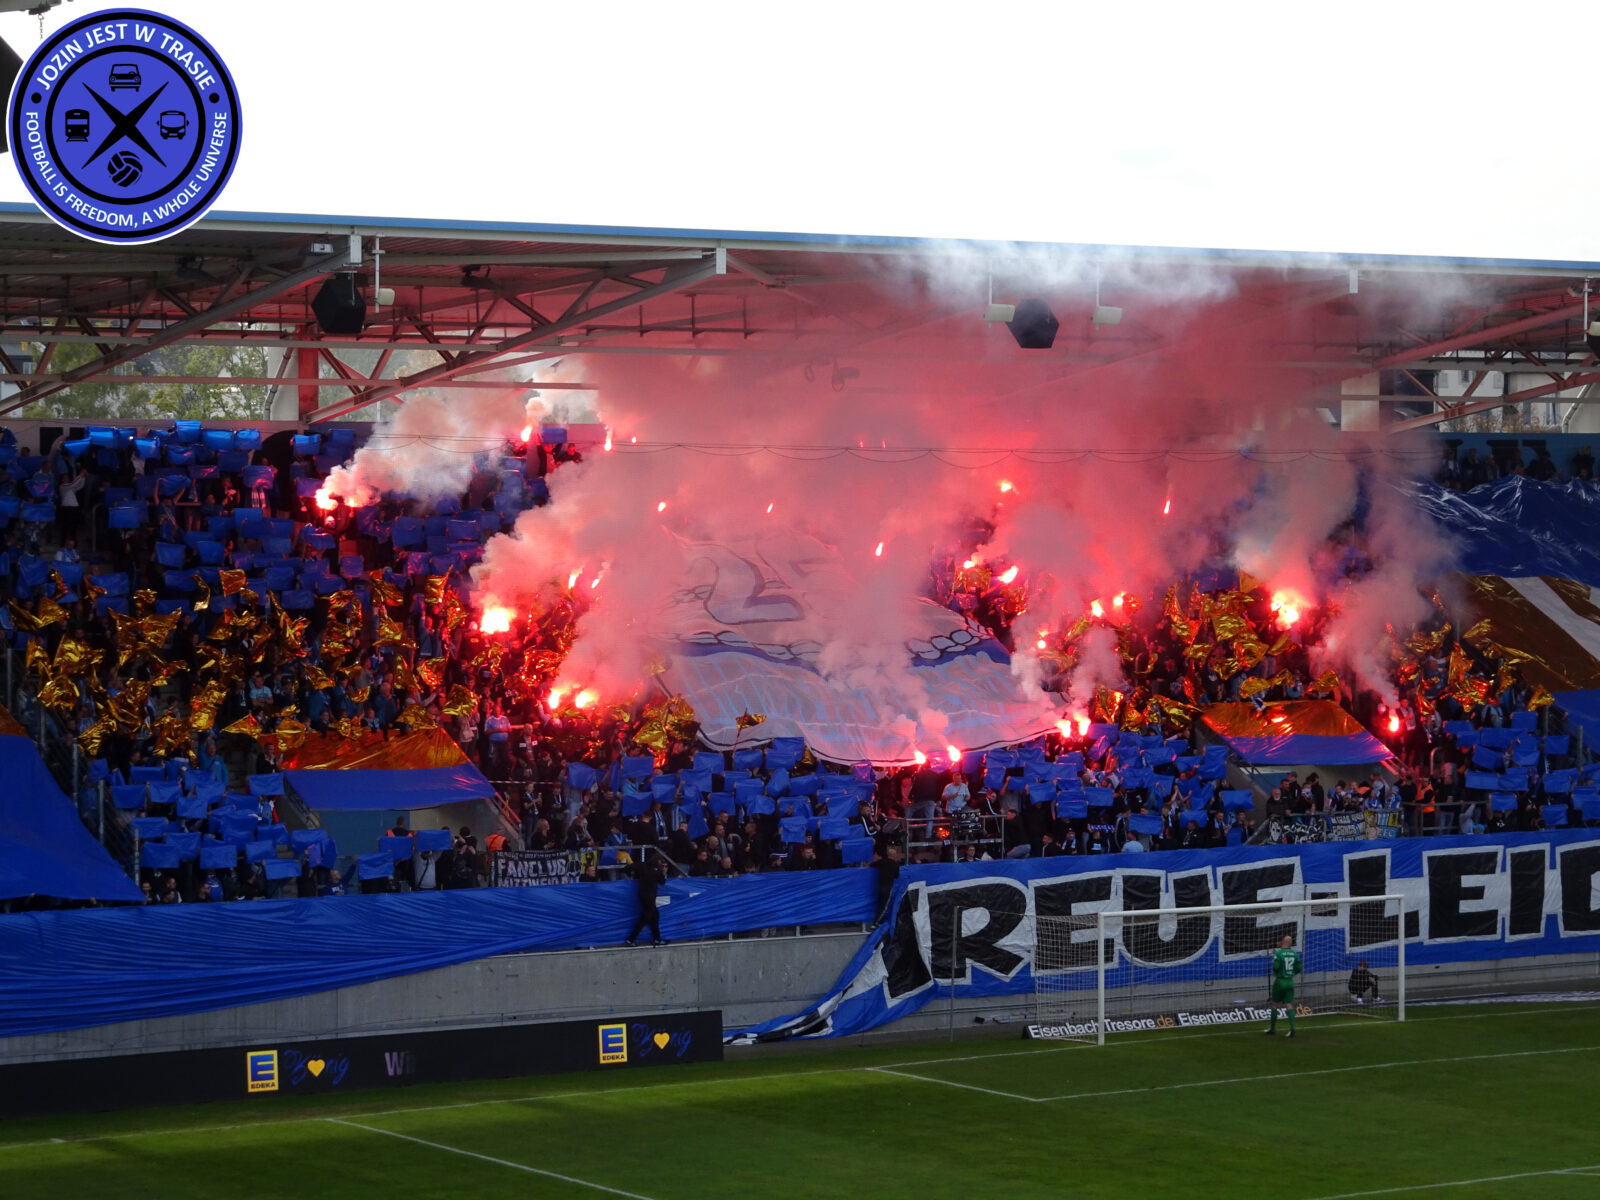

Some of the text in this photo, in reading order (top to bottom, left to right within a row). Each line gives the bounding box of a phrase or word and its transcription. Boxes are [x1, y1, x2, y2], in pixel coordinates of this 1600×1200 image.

[497, 858, 567, 878] FANCLUB
[1284, 957, 1295, 971] 12
[1177, 1007, 1246, 1025] Eisenbach
[1028, 1019, 1099, 1038] Eisenbach
